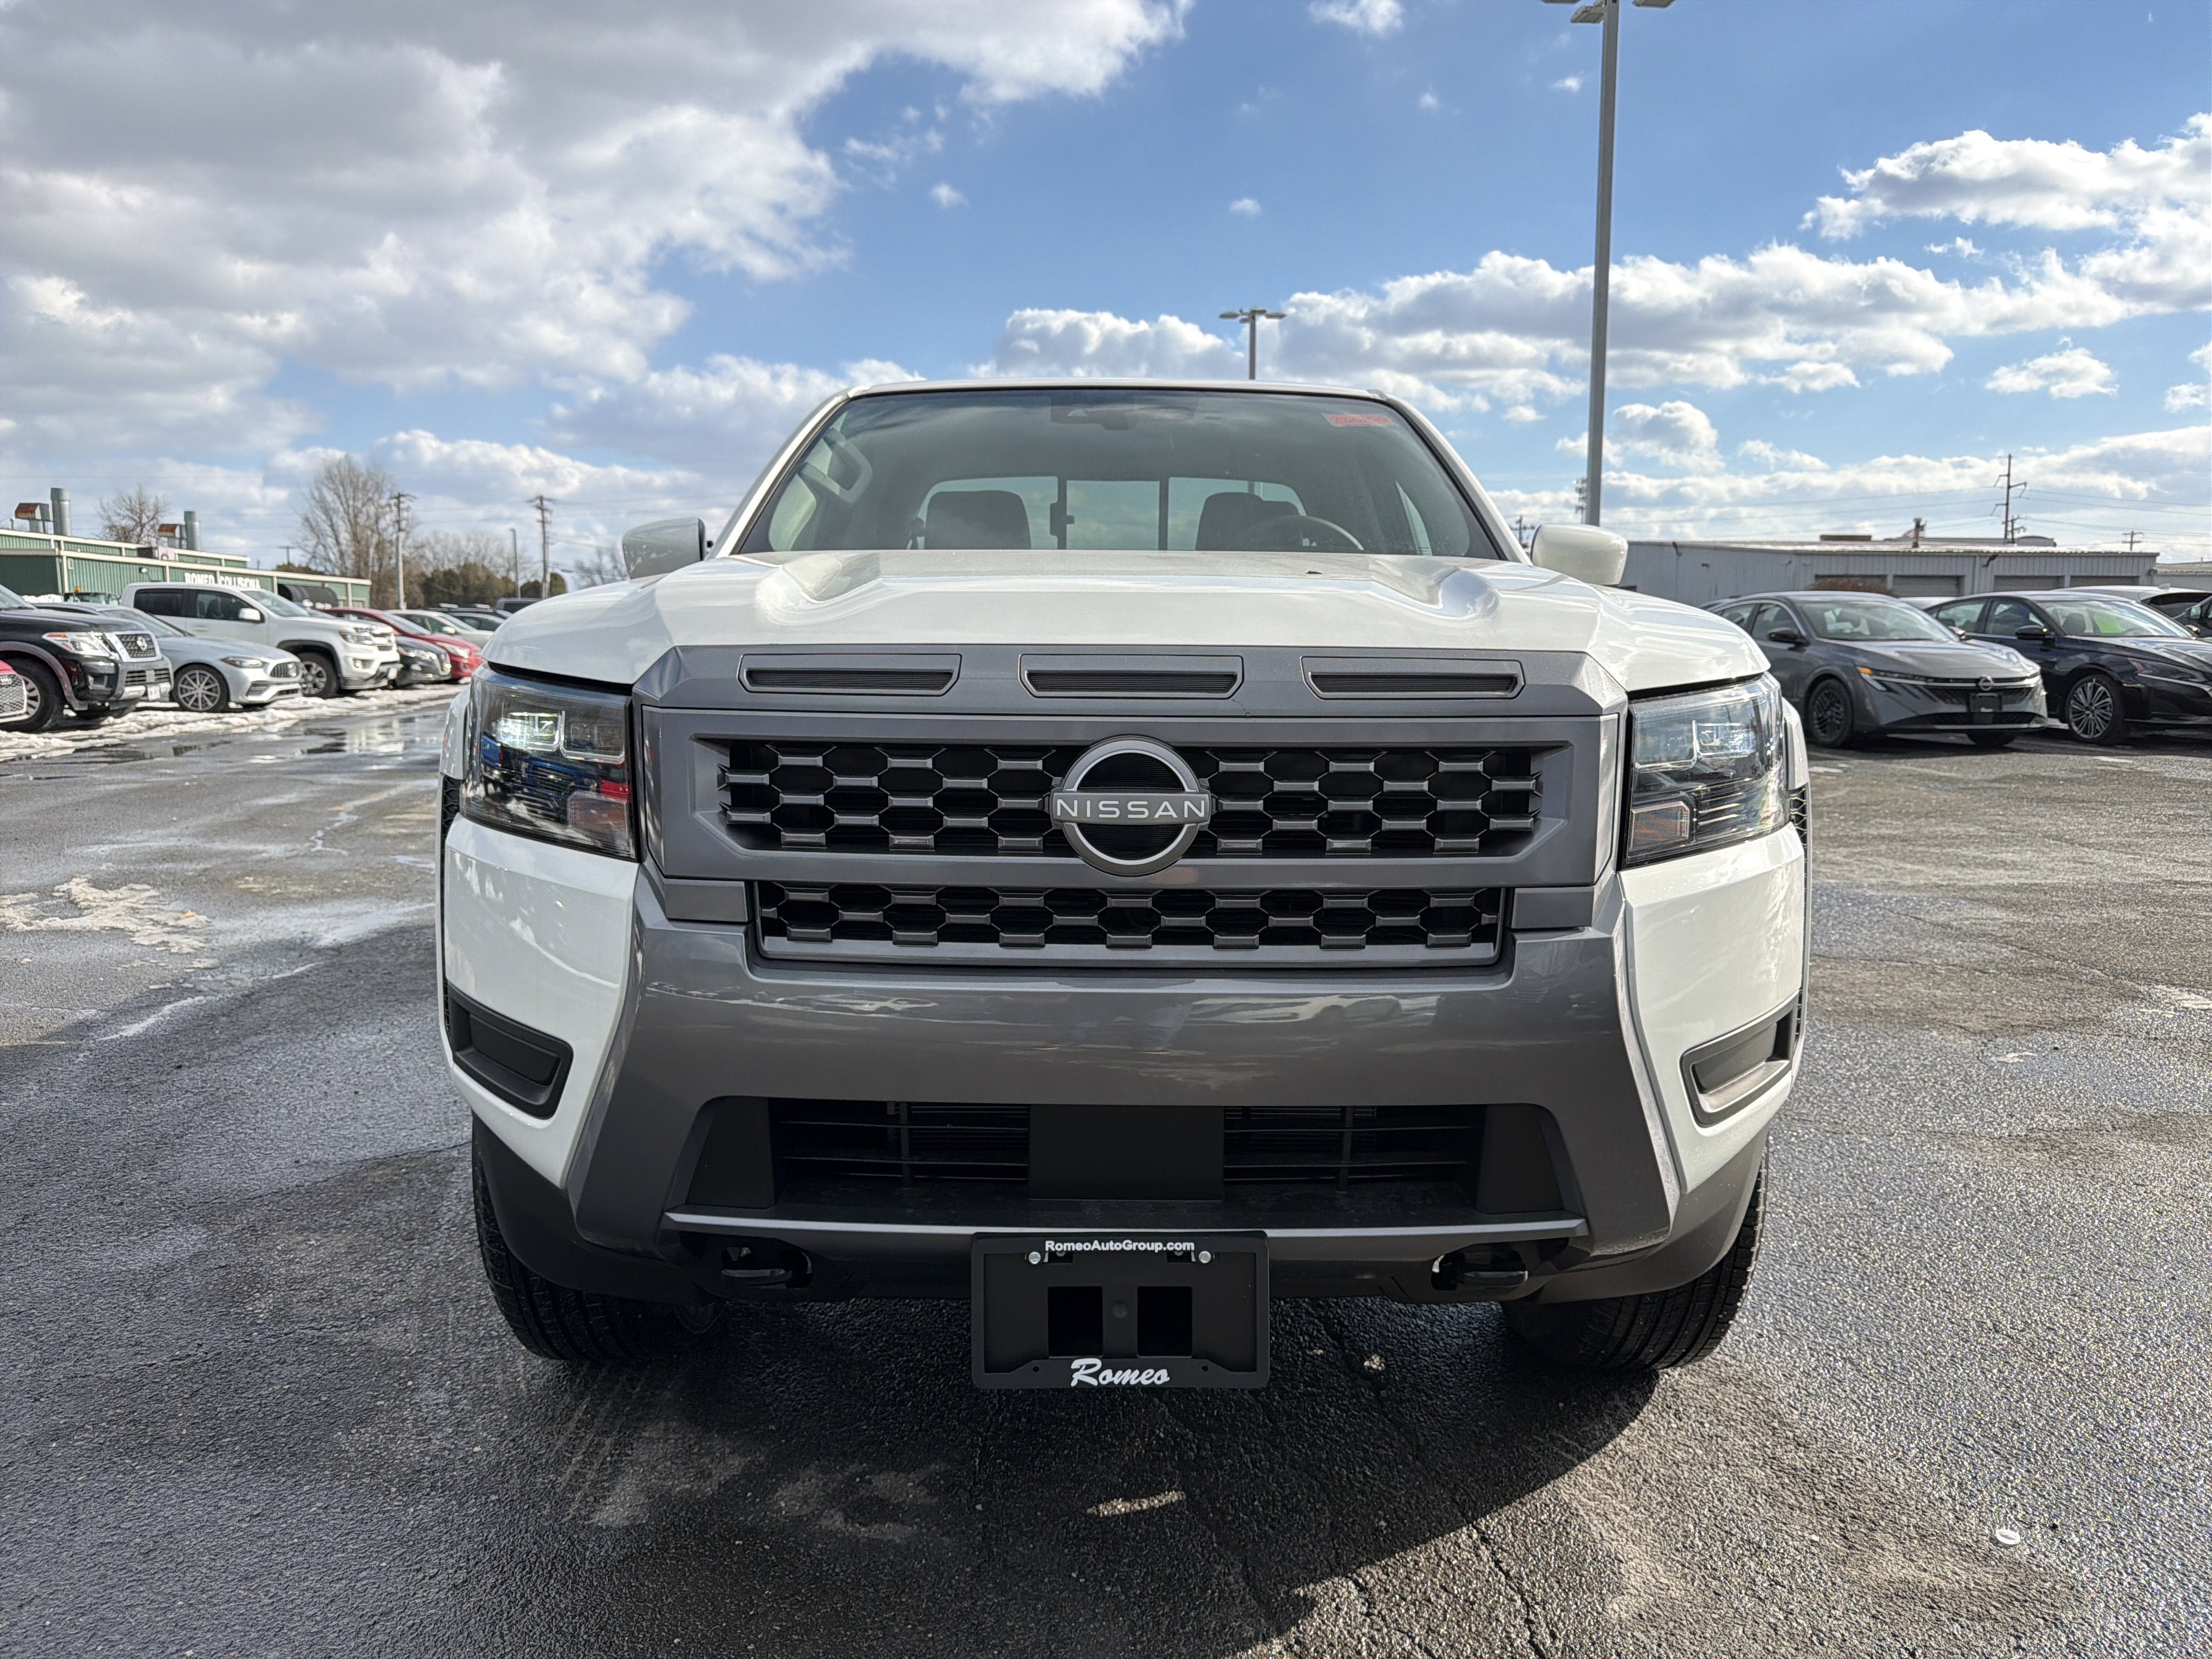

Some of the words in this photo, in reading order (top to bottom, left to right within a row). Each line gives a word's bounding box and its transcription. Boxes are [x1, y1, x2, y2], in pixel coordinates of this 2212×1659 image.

[1057, 799, 1205, 819] NISSAN
[1045, 1240, 1195, 1253] RomeoAutoGroup.com
[1071, 1358, 1170, 1387] Romeo
